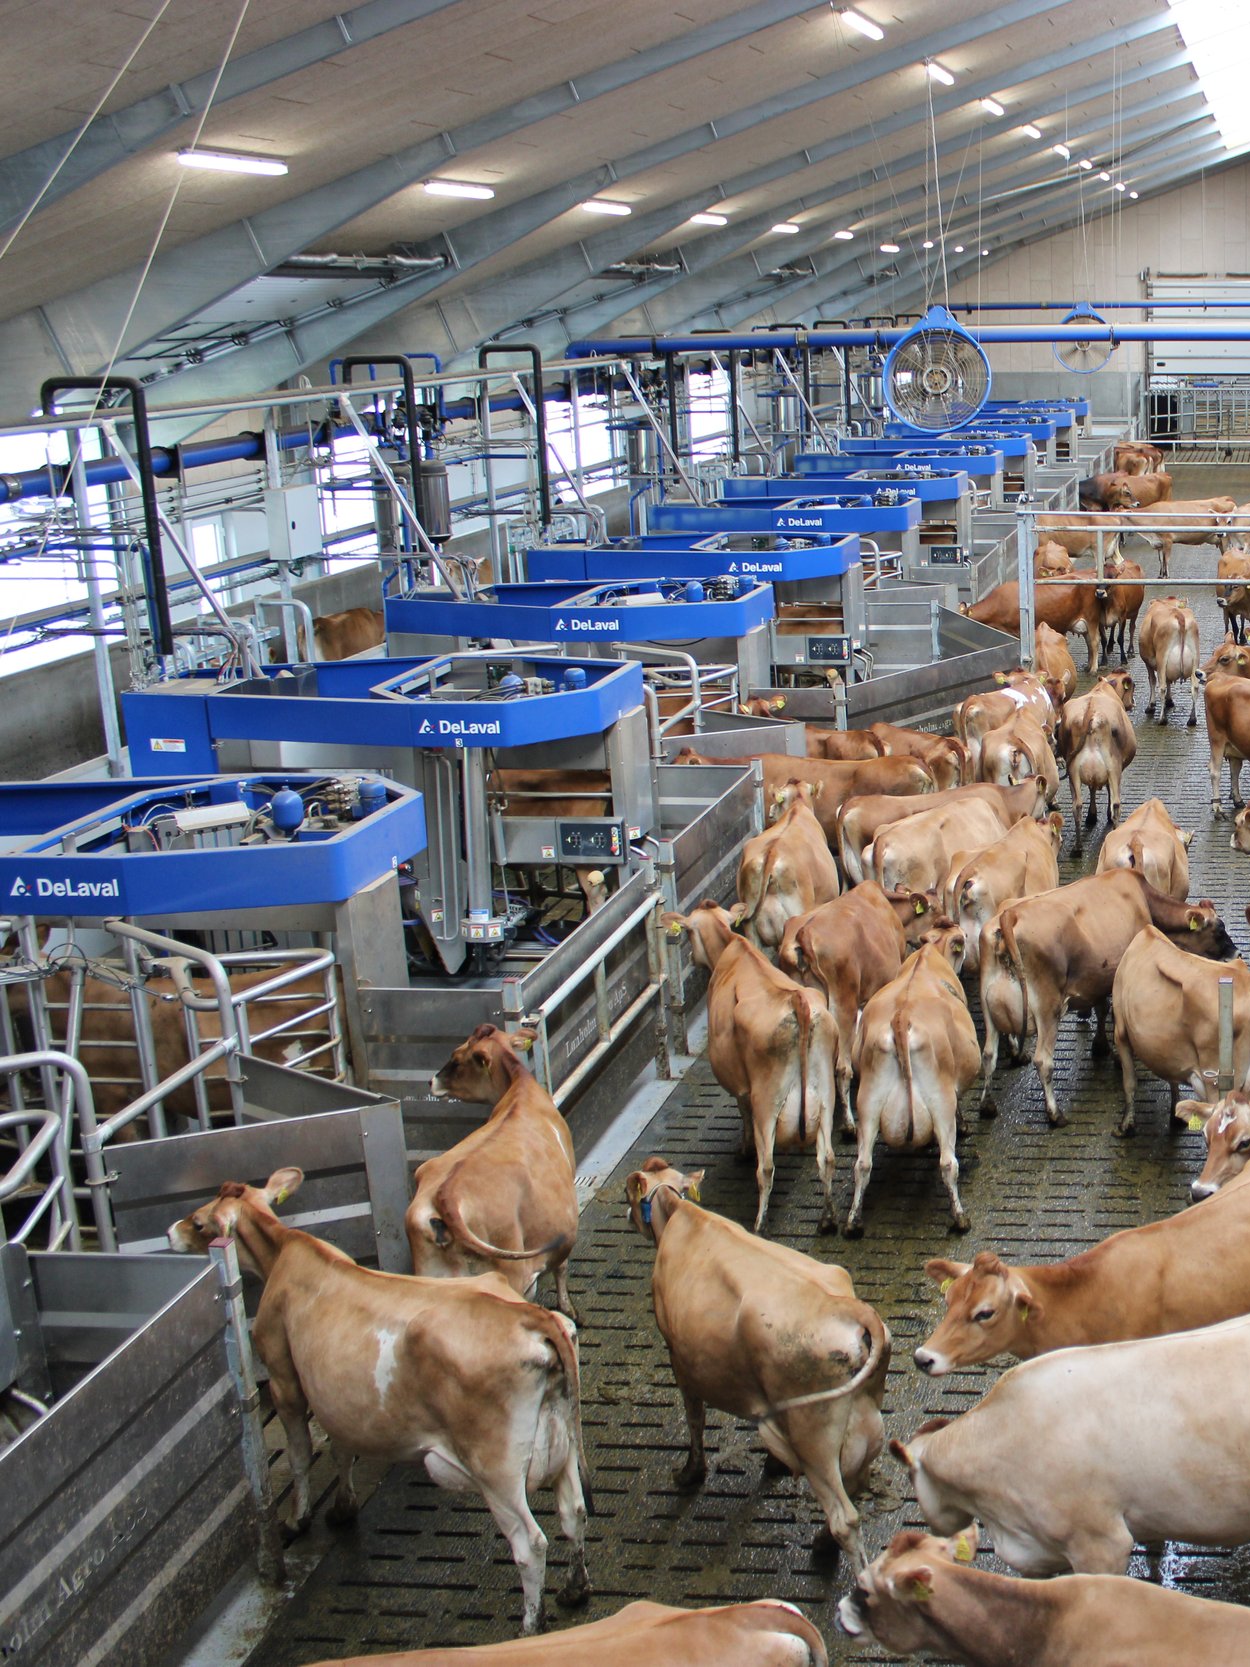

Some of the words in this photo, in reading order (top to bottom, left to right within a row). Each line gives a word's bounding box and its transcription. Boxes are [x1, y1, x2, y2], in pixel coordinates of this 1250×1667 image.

[788, 518, 823, 526] DeLaval
[742, 563, 783, 572] DeLaval
[571, 620, 619, 631] DeLaval
[439, 720, 501, 734] DeLaval
[36, 879, 119, 897] DeLaval
